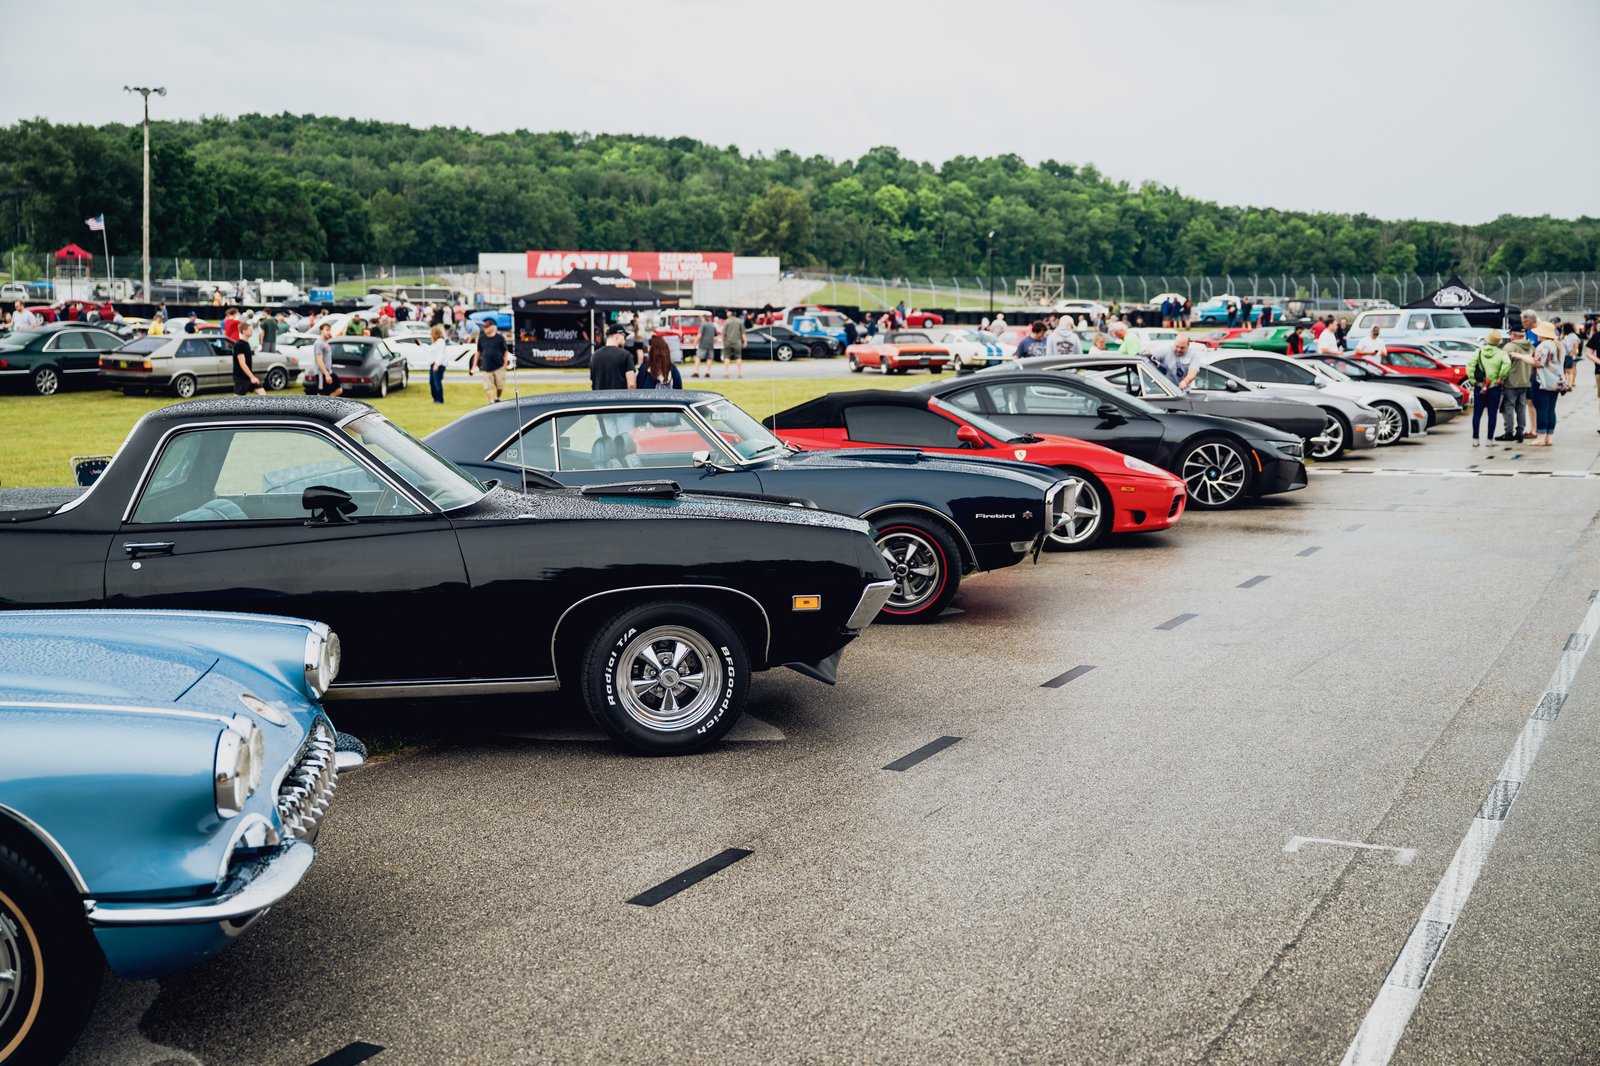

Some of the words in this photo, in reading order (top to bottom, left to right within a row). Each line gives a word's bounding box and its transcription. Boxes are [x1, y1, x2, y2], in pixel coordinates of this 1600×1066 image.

[536, 253, 632, 276] MOTUL
[604, 651, 618, 706] Radial
[616, 627, 638, 648] T/A
[696, 646, 735, 735] BFGoodrich
